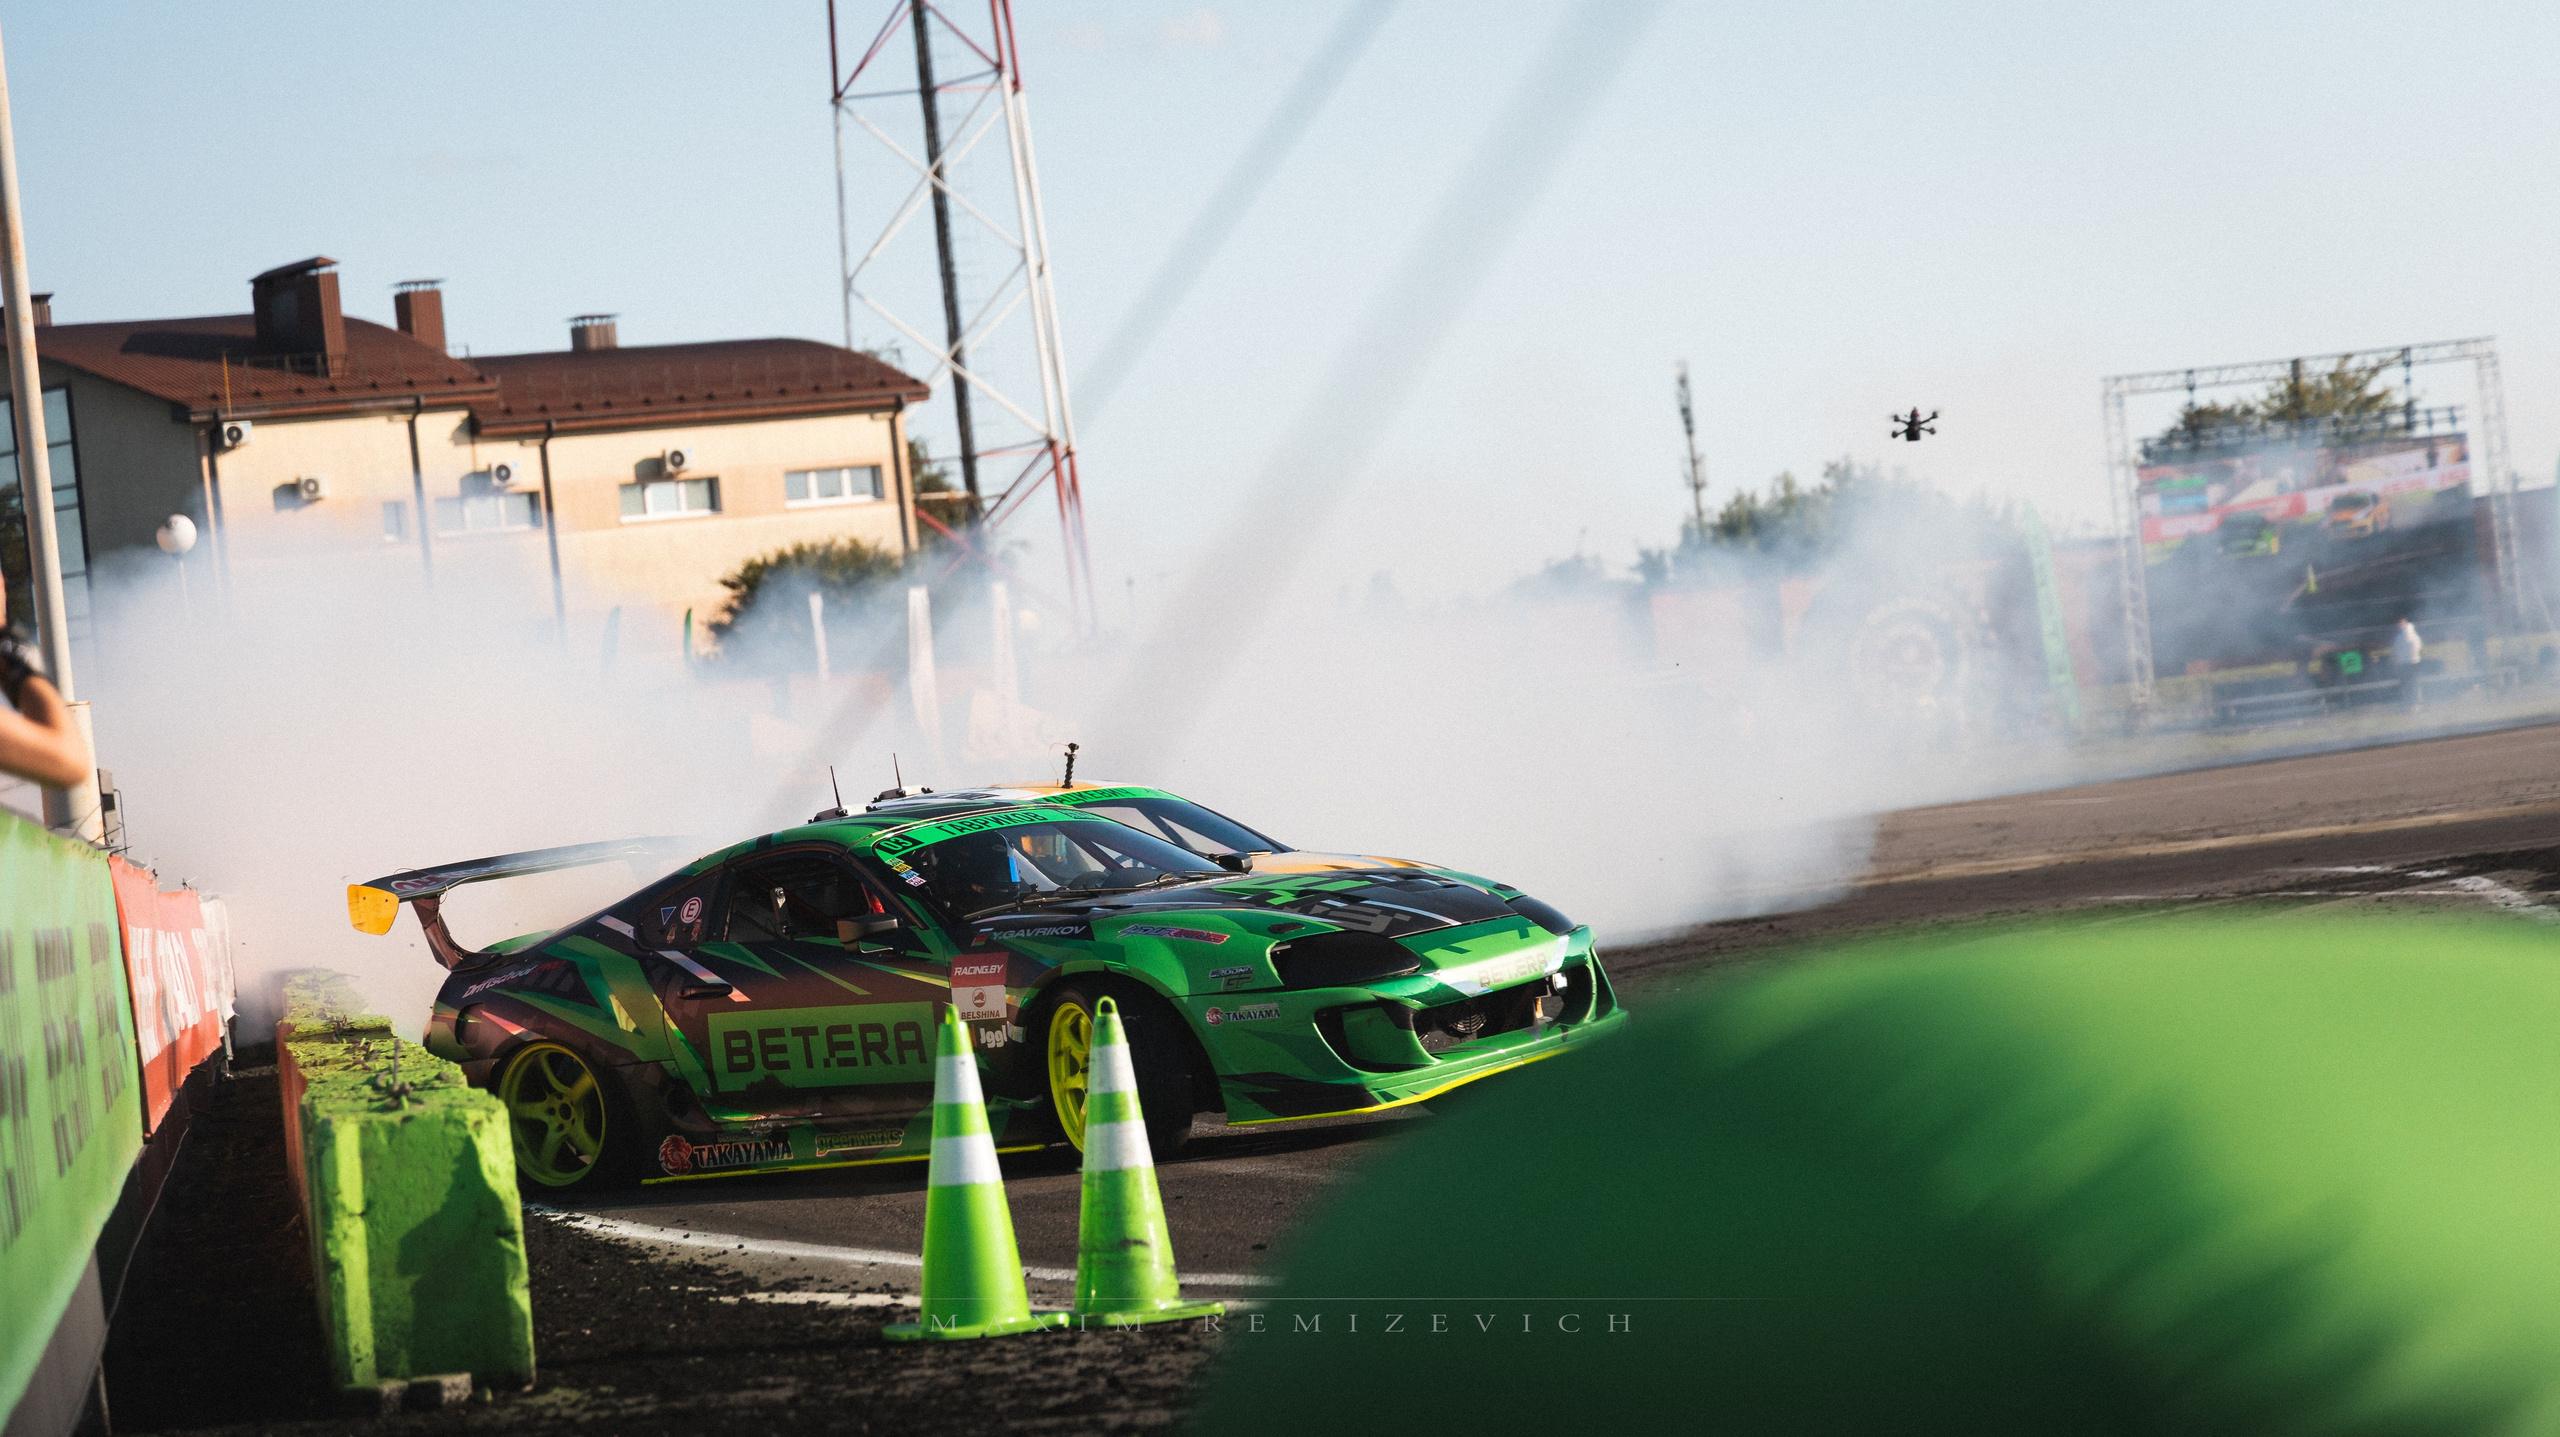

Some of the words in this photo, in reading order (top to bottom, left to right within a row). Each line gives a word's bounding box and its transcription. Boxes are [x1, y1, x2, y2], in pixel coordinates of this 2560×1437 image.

[936, 811, 1047, 835] ГАВРИКОВ
[881, 836, 913, 851] 03
[991, 925, 1086, 940] Y.GAVRIKOV
[954, 964, 1003, 976] RACING.BY
[961, 1010, 1000, 1019] BELSHINA
[1226, 1009, 1280, 1021] TAKAYAMA
[816, 1129, 900, 1153] greenworks
[694, 1140, 792, 1168] TAKAYAMA
